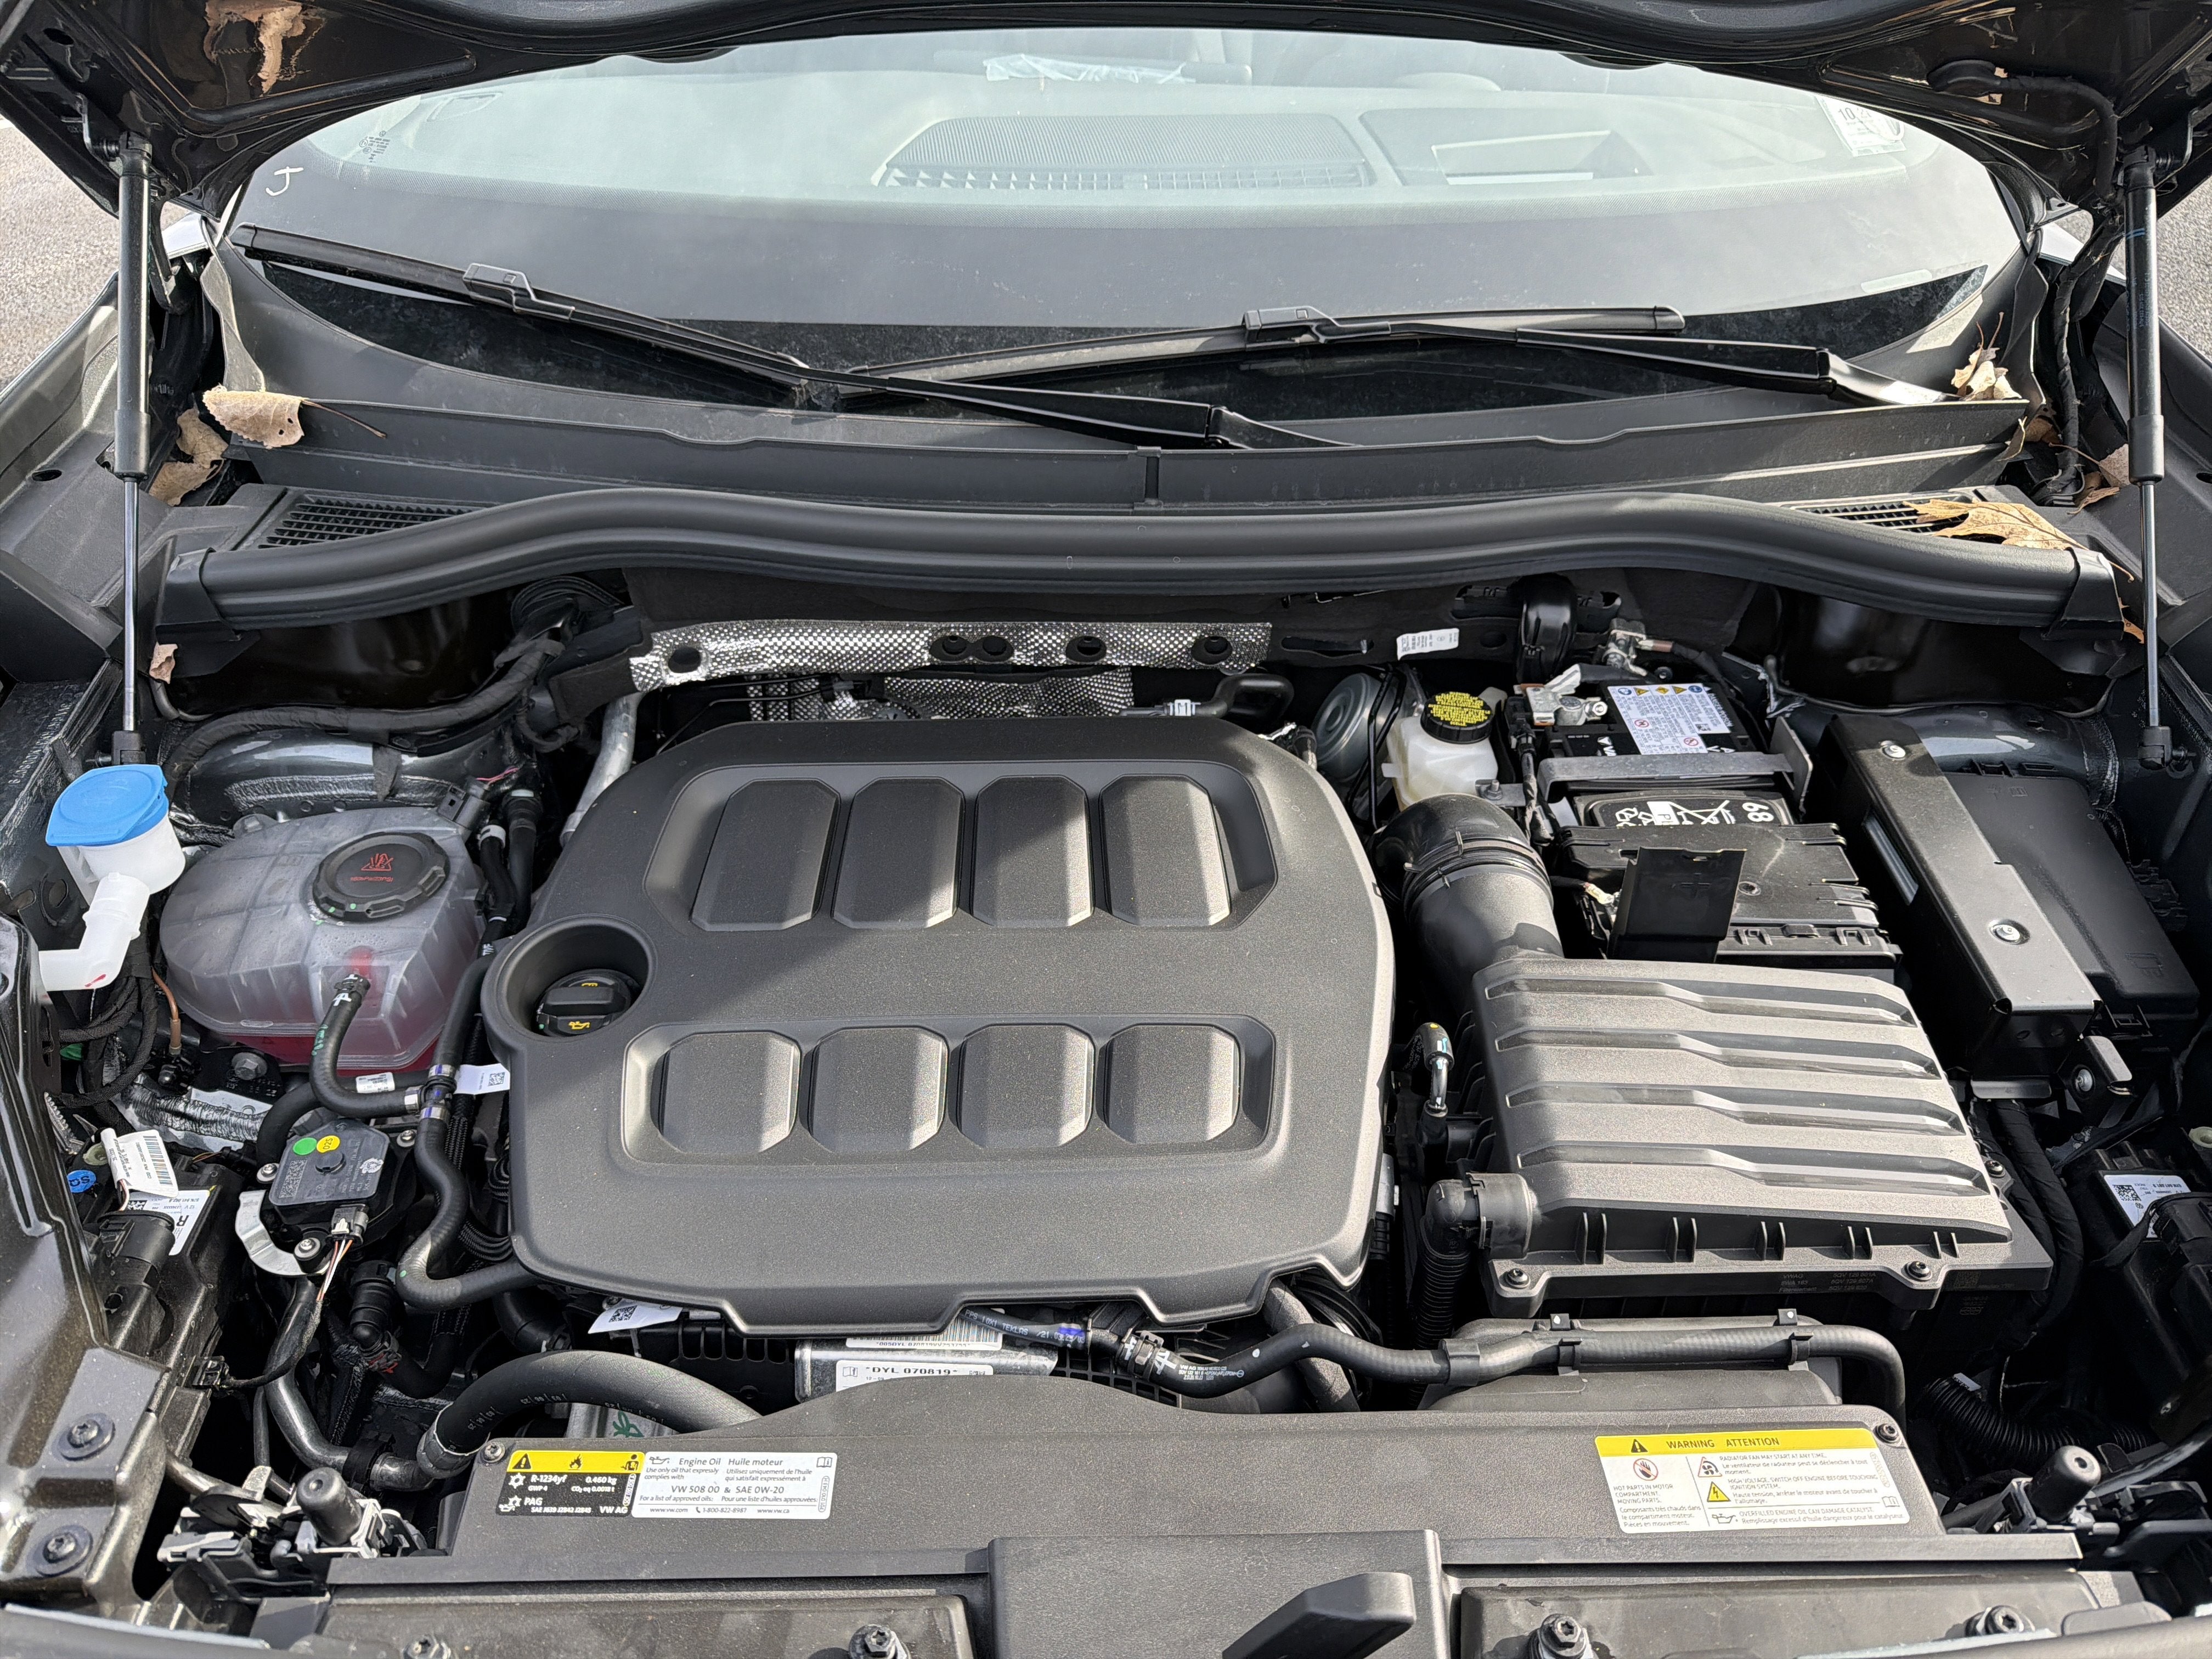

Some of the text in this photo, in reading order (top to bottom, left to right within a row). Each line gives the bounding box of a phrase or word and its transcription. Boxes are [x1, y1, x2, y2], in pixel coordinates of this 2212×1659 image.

[1742, 802, 1774, 822] 68
[177, 1215, 189, 1227] R
[964, 1309, 979, 1320] PPS
[1002, 1322, 1029, 1335] TEKLAS
[1666, 1437, 1780, 1449] WARNING ATTENTION
[679, 1458, 708, 1466] Engine
[531, 1475, 568, 1485] R-1234yf
[607, 1476, 617, 1486] kg
[524, 1497, 543, 1505] PAG
